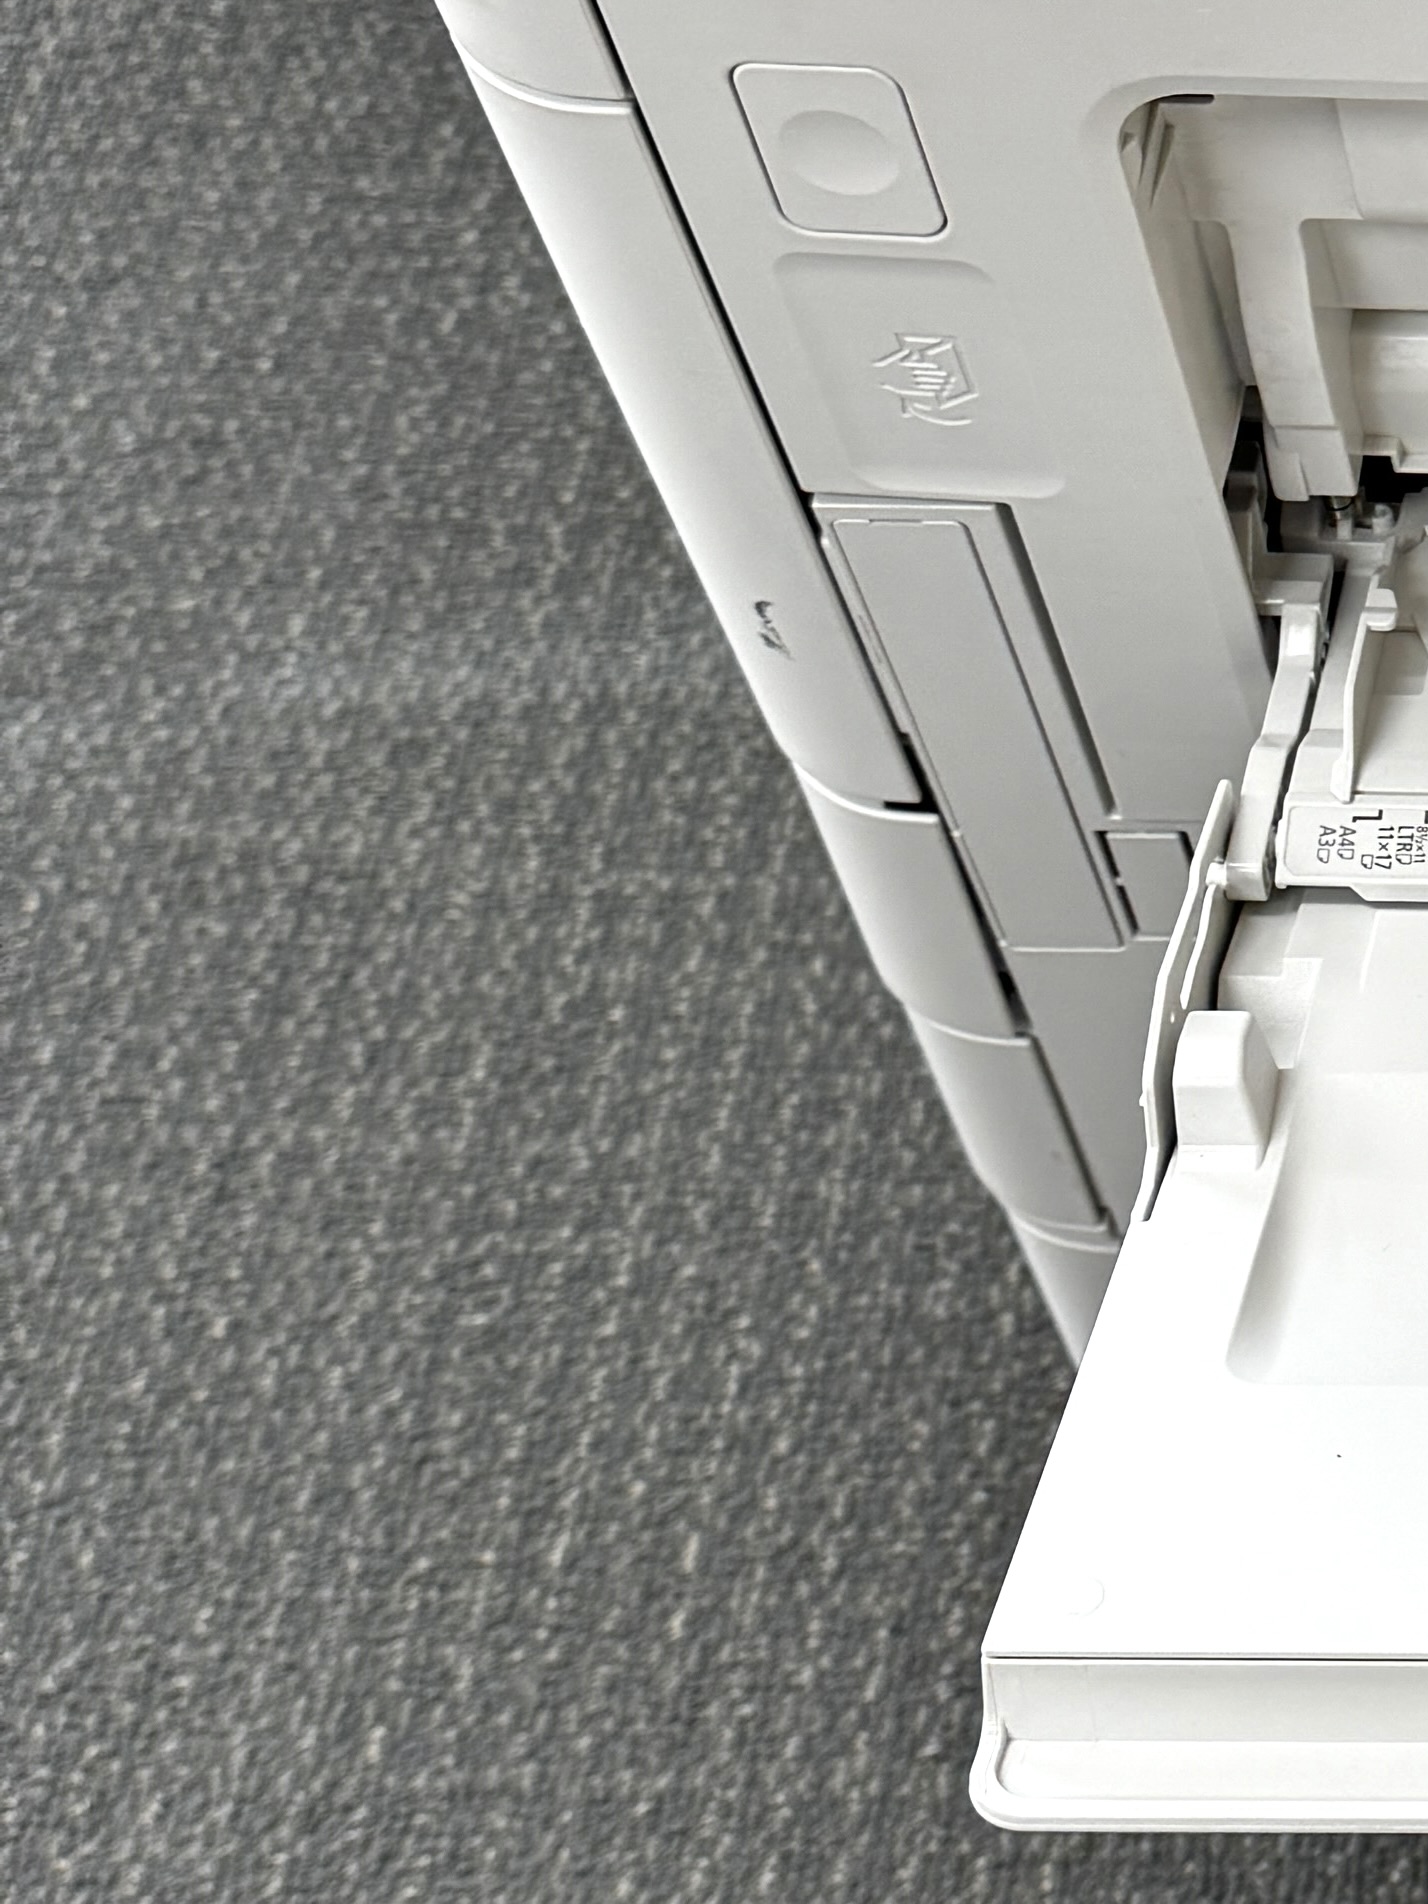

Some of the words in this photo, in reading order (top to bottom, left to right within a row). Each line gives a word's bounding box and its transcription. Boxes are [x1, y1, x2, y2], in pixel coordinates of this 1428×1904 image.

[1318, 825, 1336, 847] A3
[1338, 825, 1356, 847] A4
[1395, 826, 1414, 852] LTR
